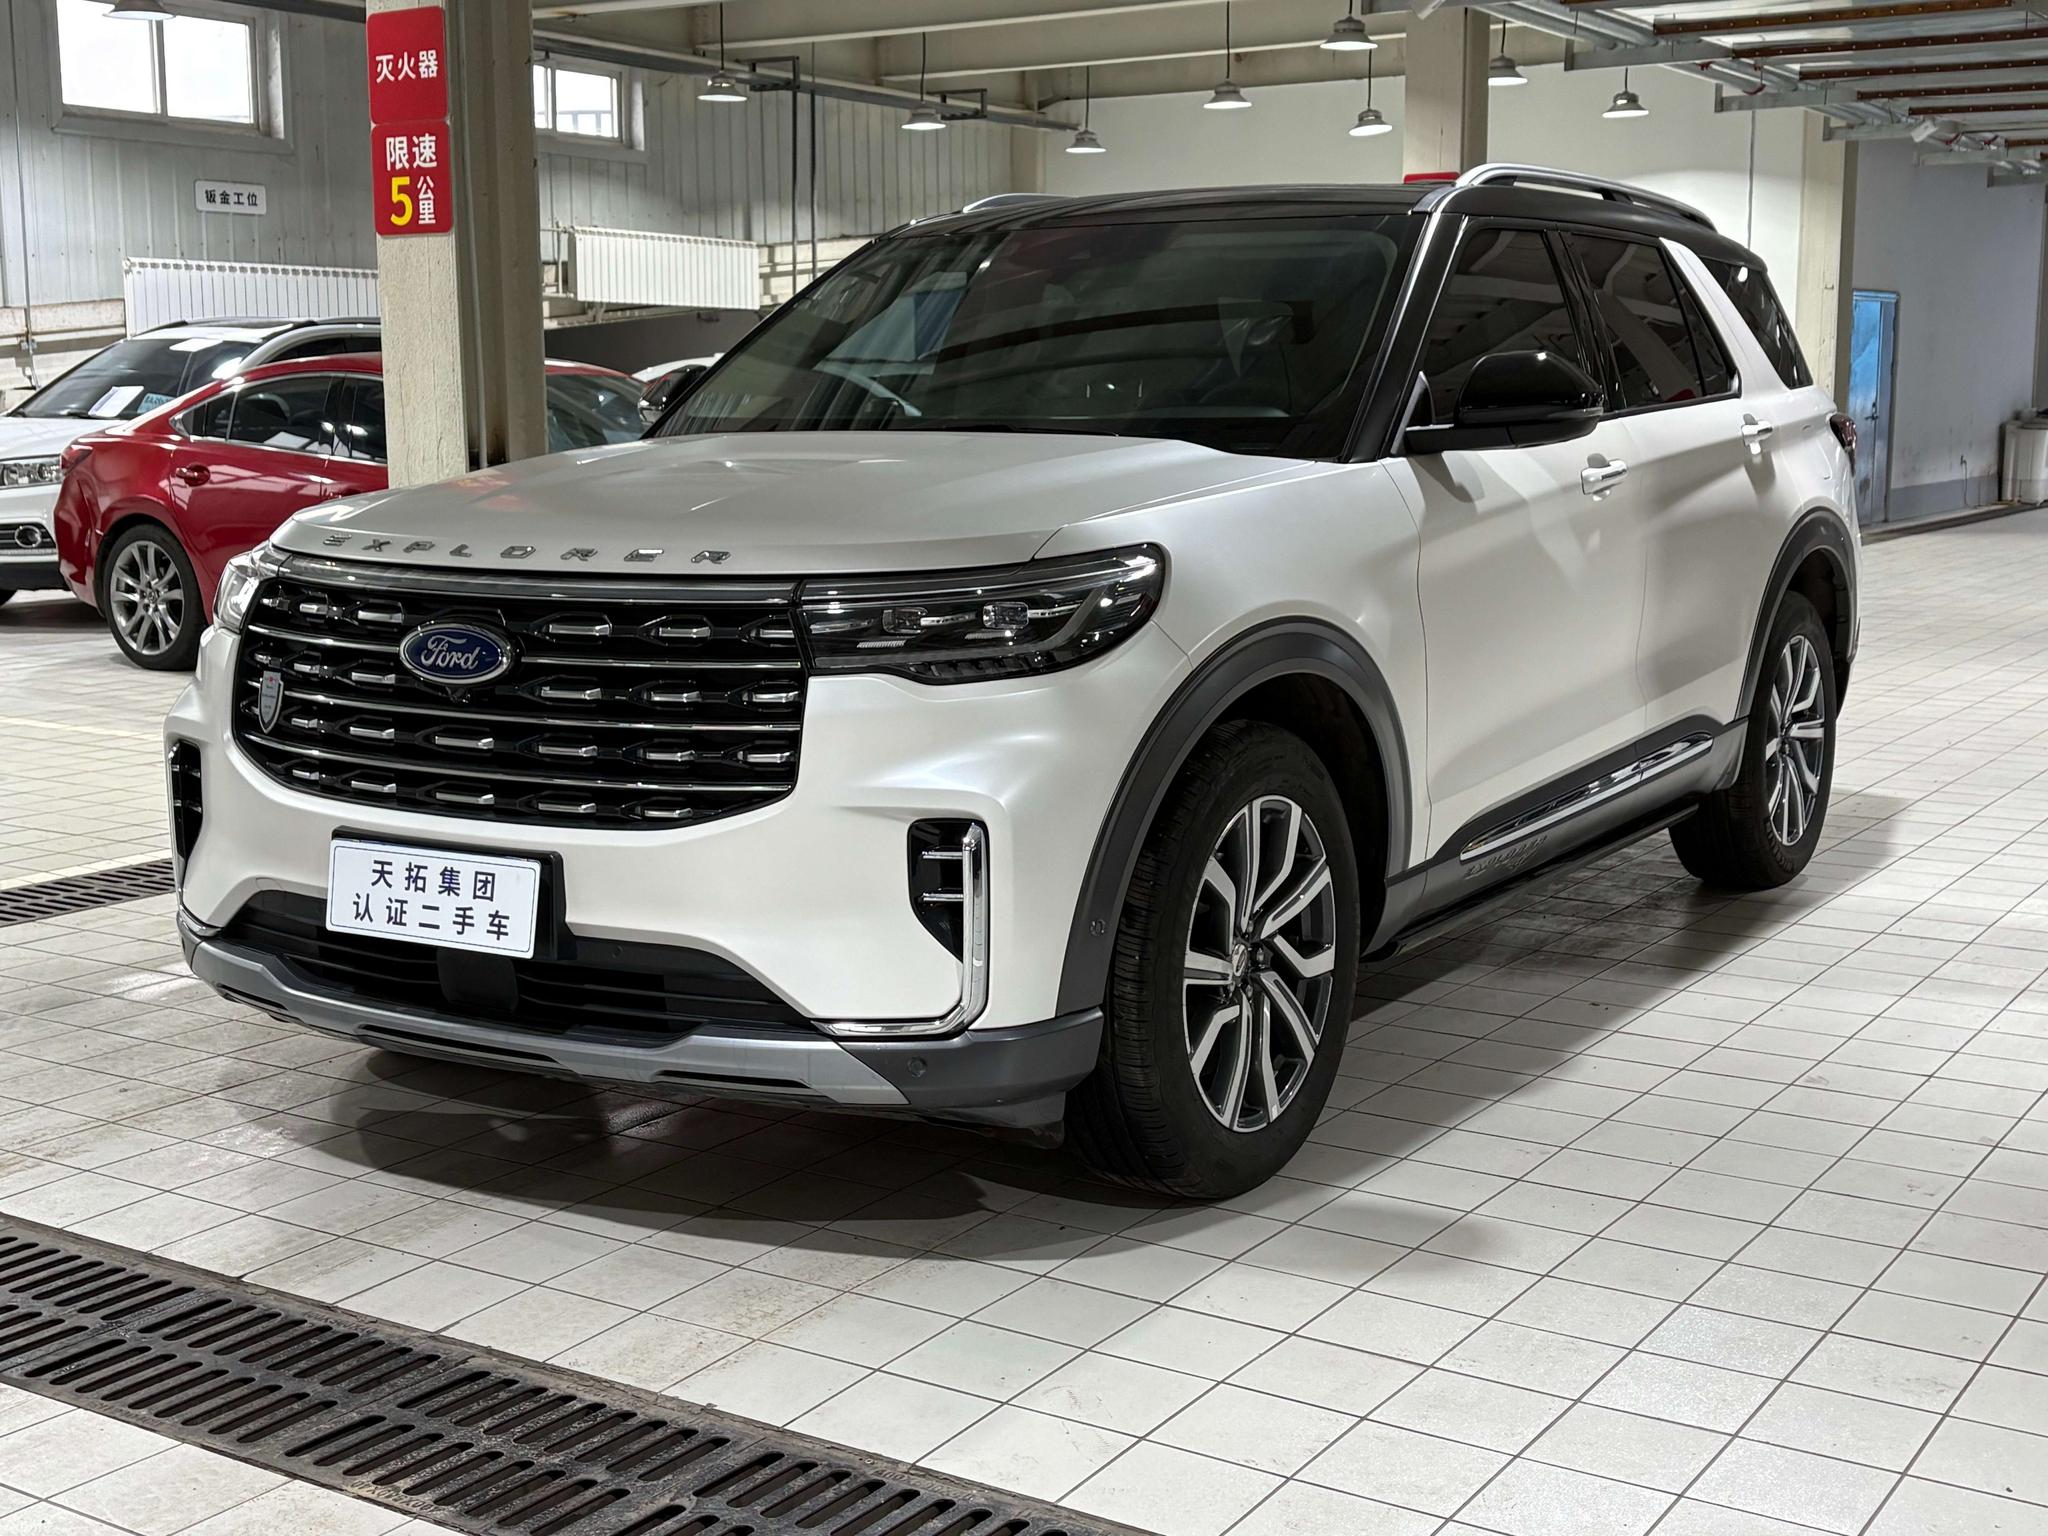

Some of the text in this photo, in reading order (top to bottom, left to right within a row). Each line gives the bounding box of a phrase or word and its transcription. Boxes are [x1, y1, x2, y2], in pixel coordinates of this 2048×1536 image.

[375, 50, 439, 83] 灭火器
[385, 133, 438, 172] 限速
[204, 188, 258, 207] 钣金工位
[390, 175, 437, 226] 5 公里
[323, 534, 731, 565] EXPLORER
[421, 634, 481, 670] Ford
[371, 859, 496, 902] 天拓集团
[352, 892, 510, 941] 认证二手车
